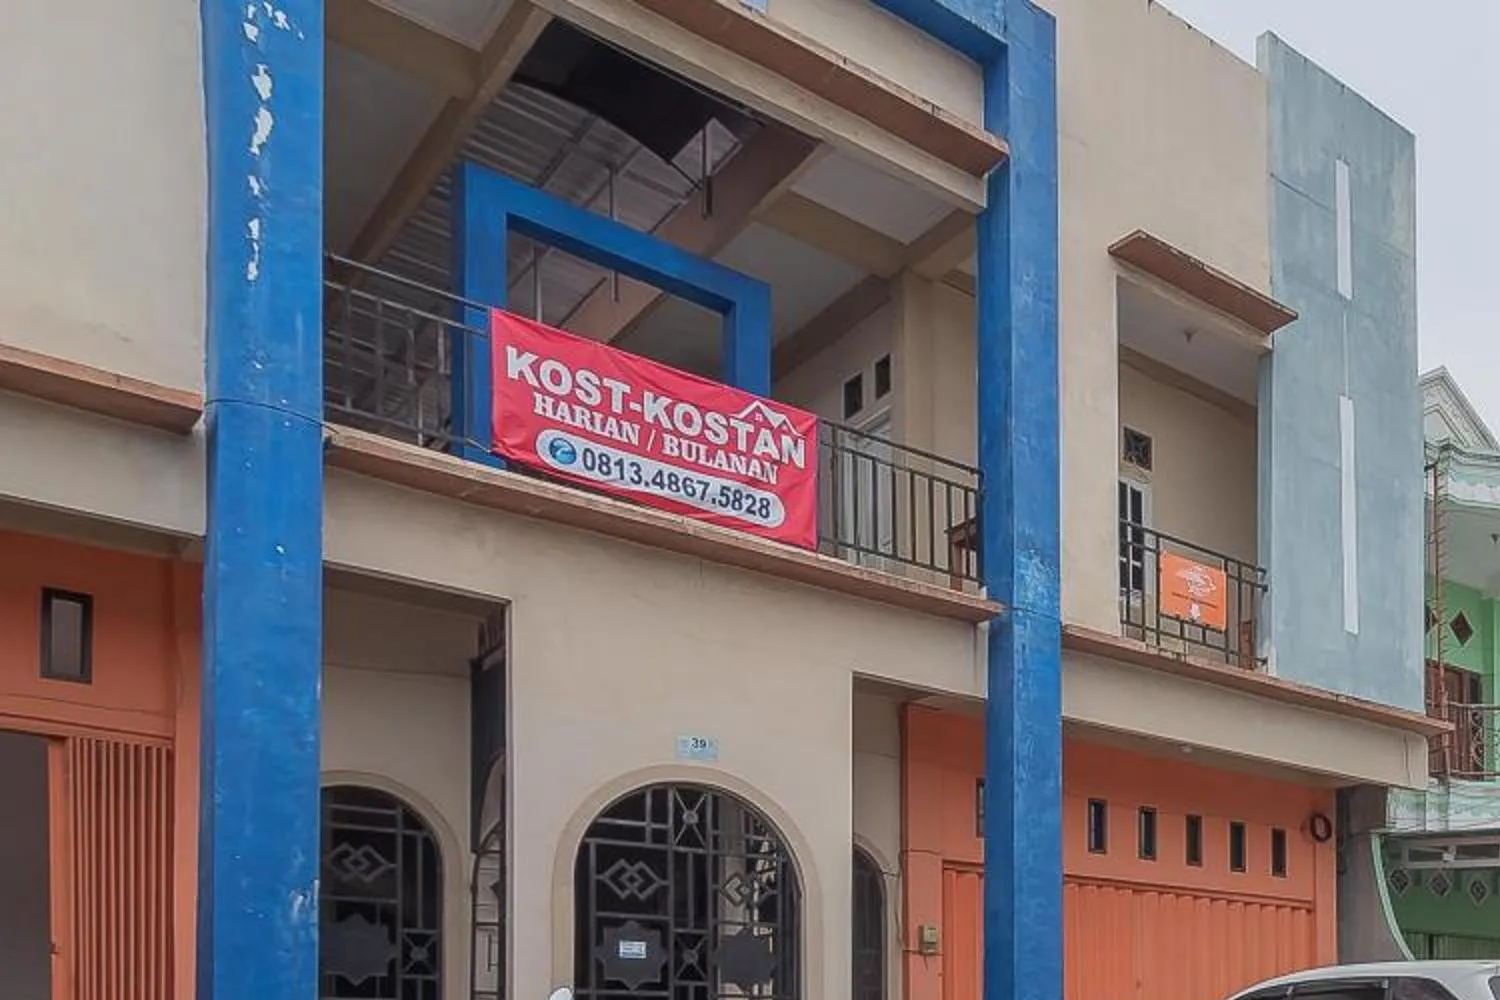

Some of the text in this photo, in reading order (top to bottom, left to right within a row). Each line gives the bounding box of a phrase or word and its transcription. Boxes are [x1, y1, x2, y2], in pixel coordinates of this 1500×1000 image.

[505, 344, 805, 468] KOST-KOSTAN
[534, 392, 640, 446] HARIAN
[663, 435, 777, 485] BULANAN
[582, 447, 771, 519] 0813.4867.5828
